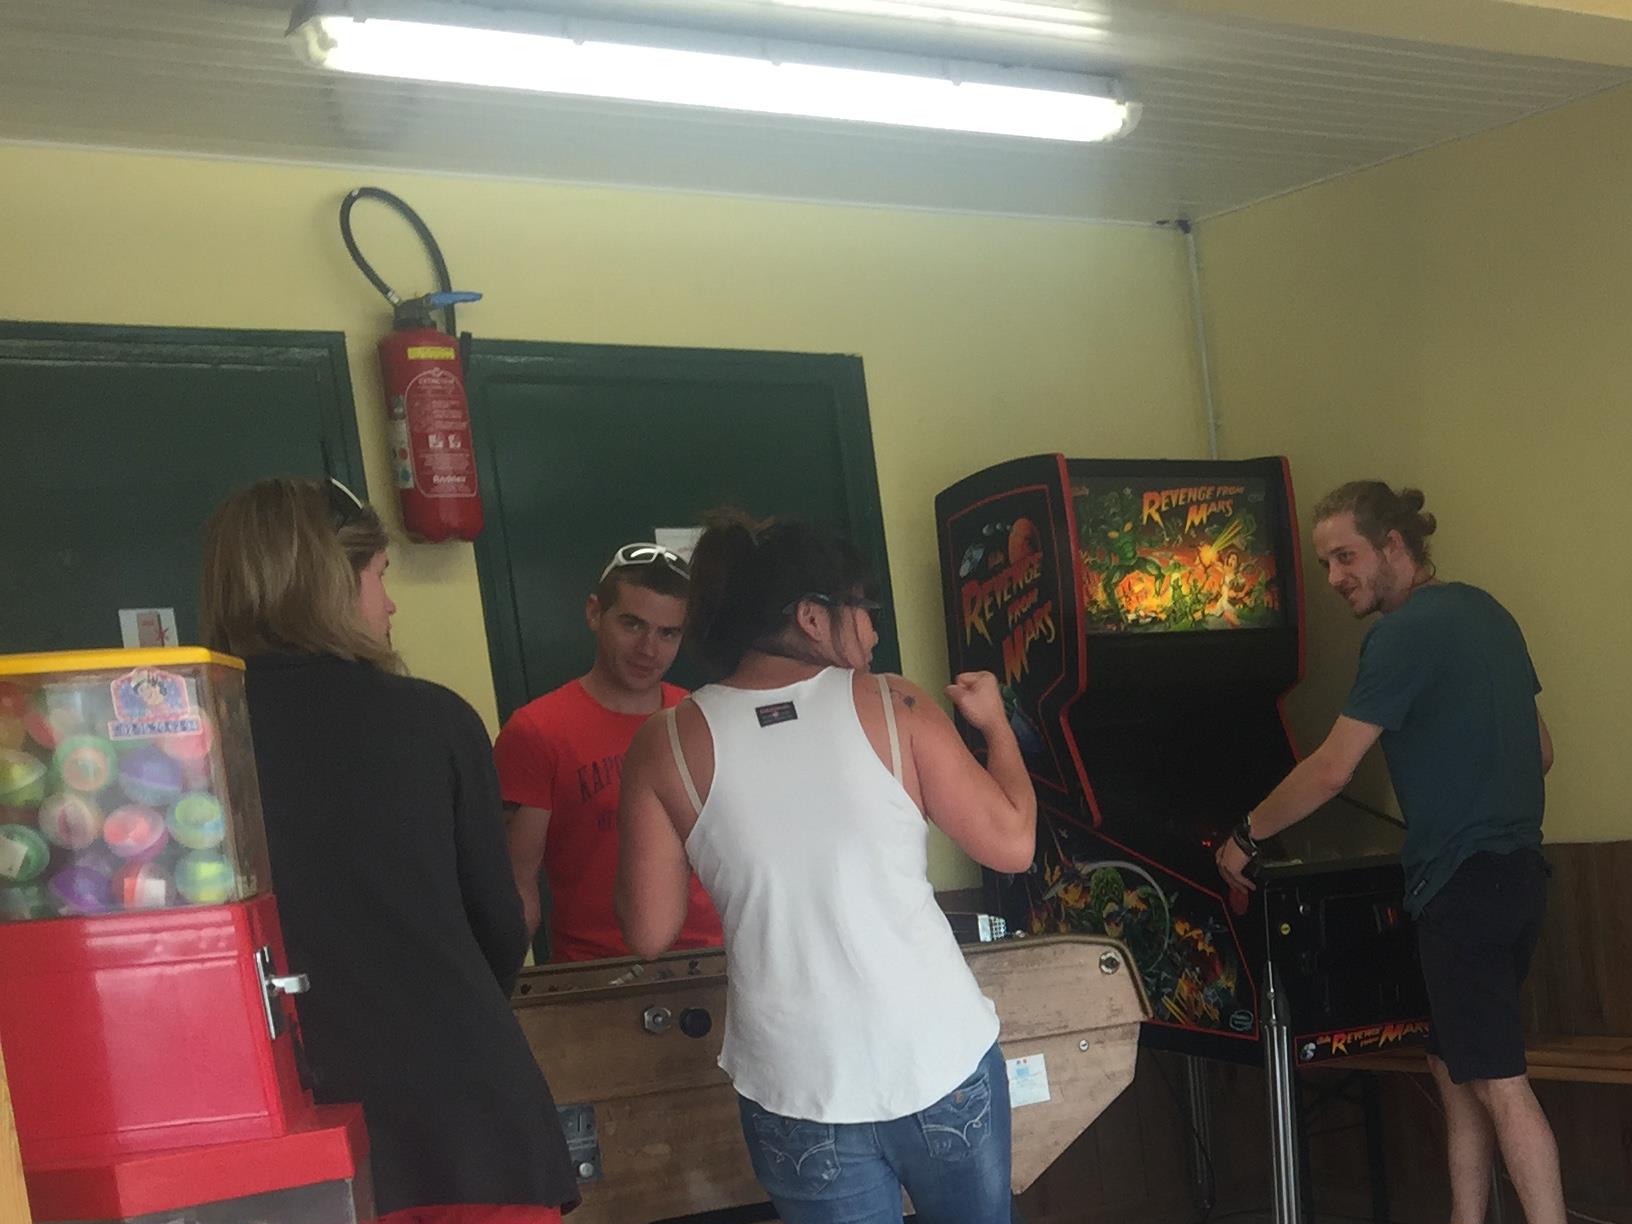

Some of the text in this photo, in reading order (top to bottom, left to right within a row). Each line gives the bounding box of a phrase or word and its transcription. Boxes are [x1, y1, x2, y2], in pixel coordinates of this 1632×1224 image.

[1142, 485, 1246, 528] REVENGE FROM
[1184, 499, 1234, 534] MARS
[961, 551, 1043, 647] REVENGE
[1001, 600, 1055, 688] MARS
